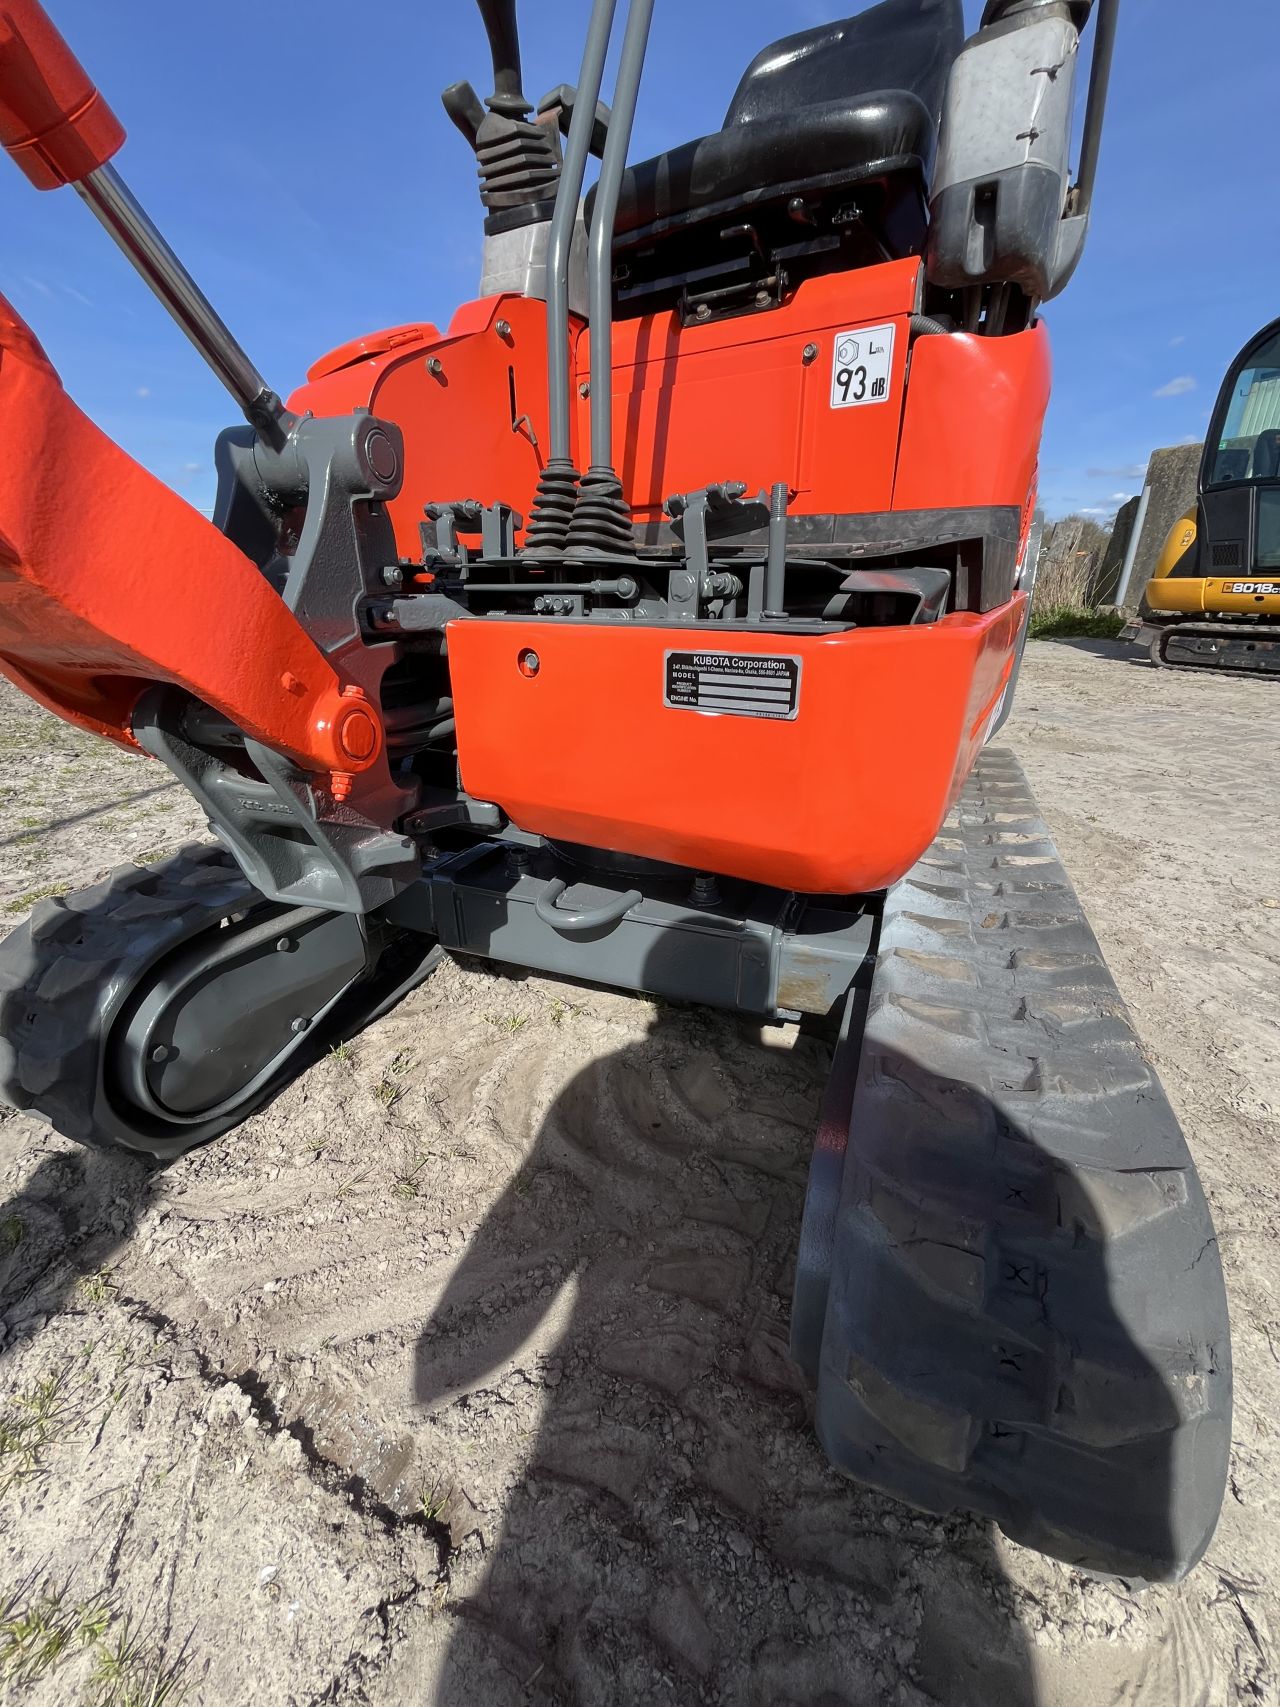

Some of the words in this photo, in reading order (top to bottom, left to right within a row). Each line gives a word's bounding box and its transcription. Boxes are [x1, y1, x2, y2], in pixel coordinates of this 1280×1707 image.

[836, 365, 867, 402] 93
[871, 377, 886, 397] dB
[693, 655, 730, 667] KUBOTA
[732, 658, 786, 670] Corporation
[672, 671, 696, 679] MODEL
